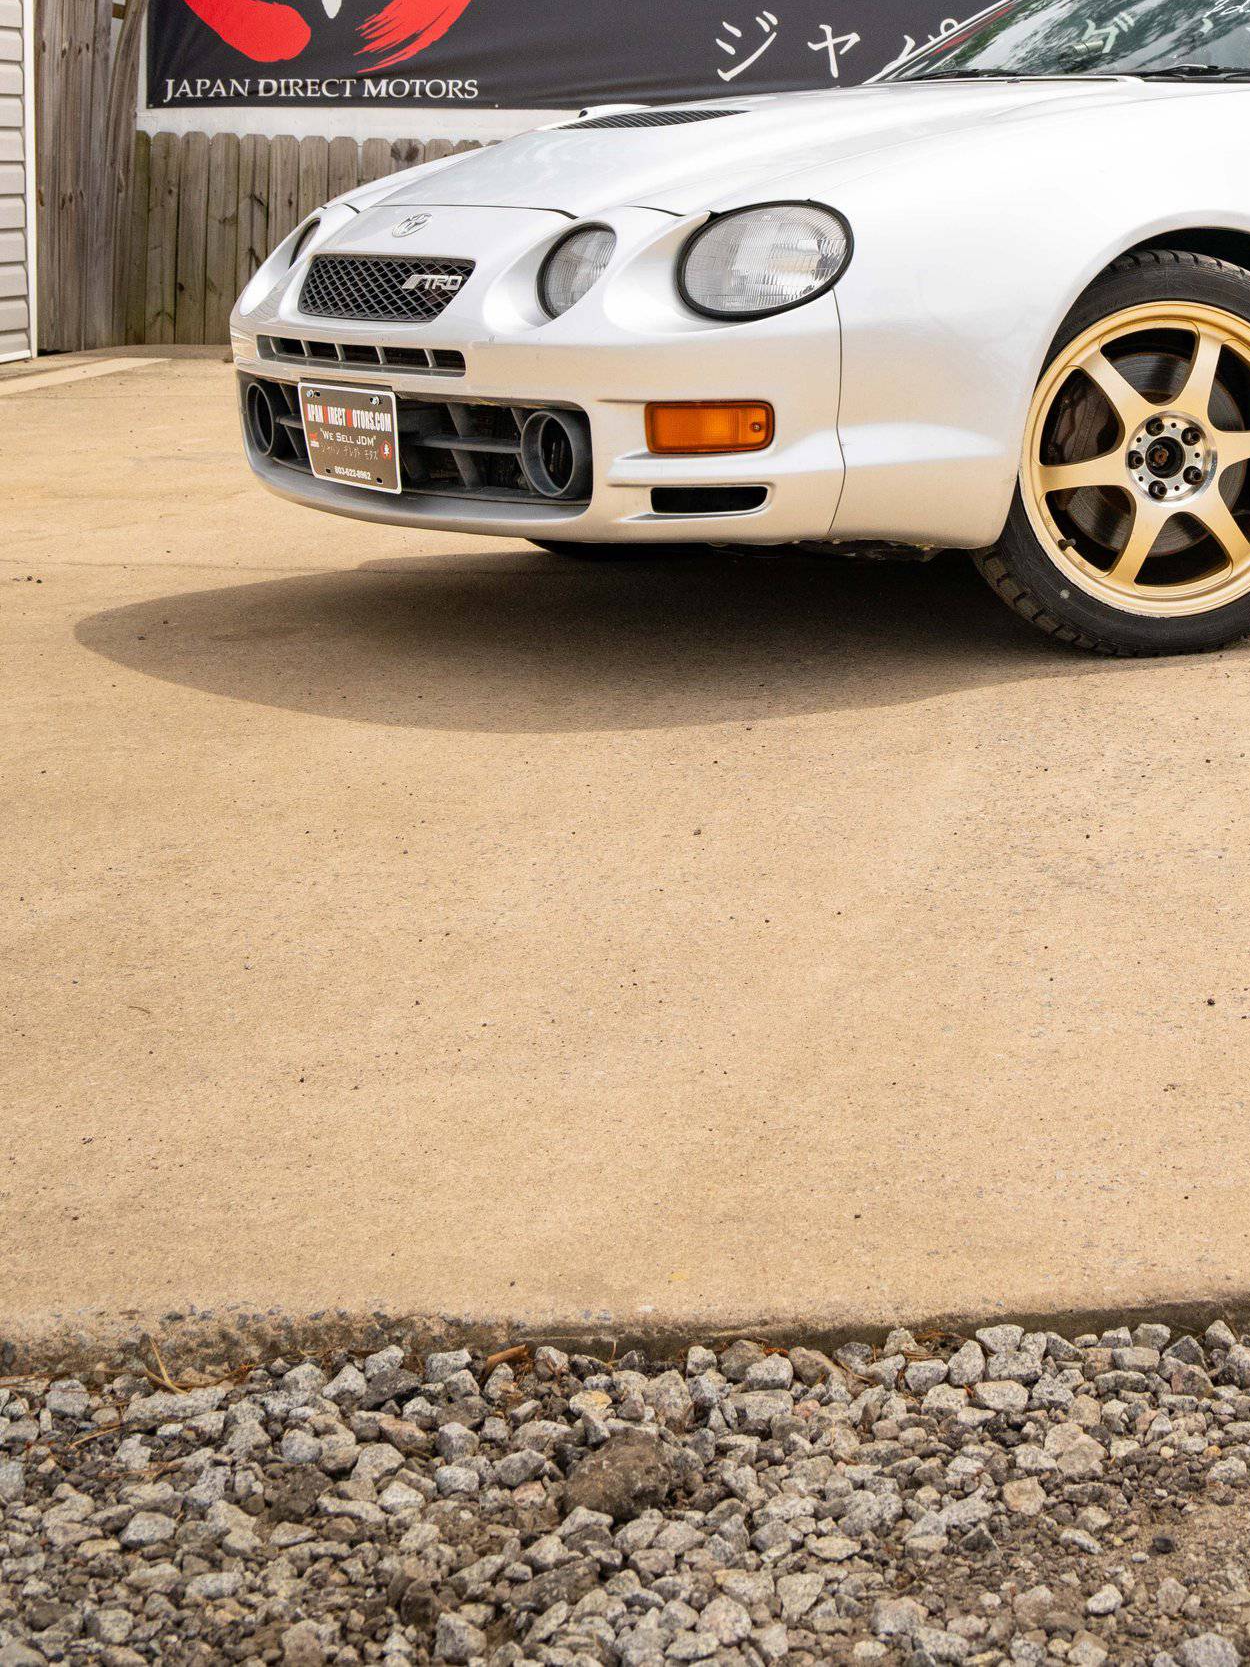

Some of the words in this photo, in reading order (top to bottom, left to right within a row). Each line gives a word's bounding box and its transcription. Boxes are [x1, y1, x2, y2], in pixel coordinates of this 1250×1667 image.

[163, 78, 251, 103] JAPAN
[257, 78, 357, 99] DIRECT
[363, 78, 480, 100] MOTORS
